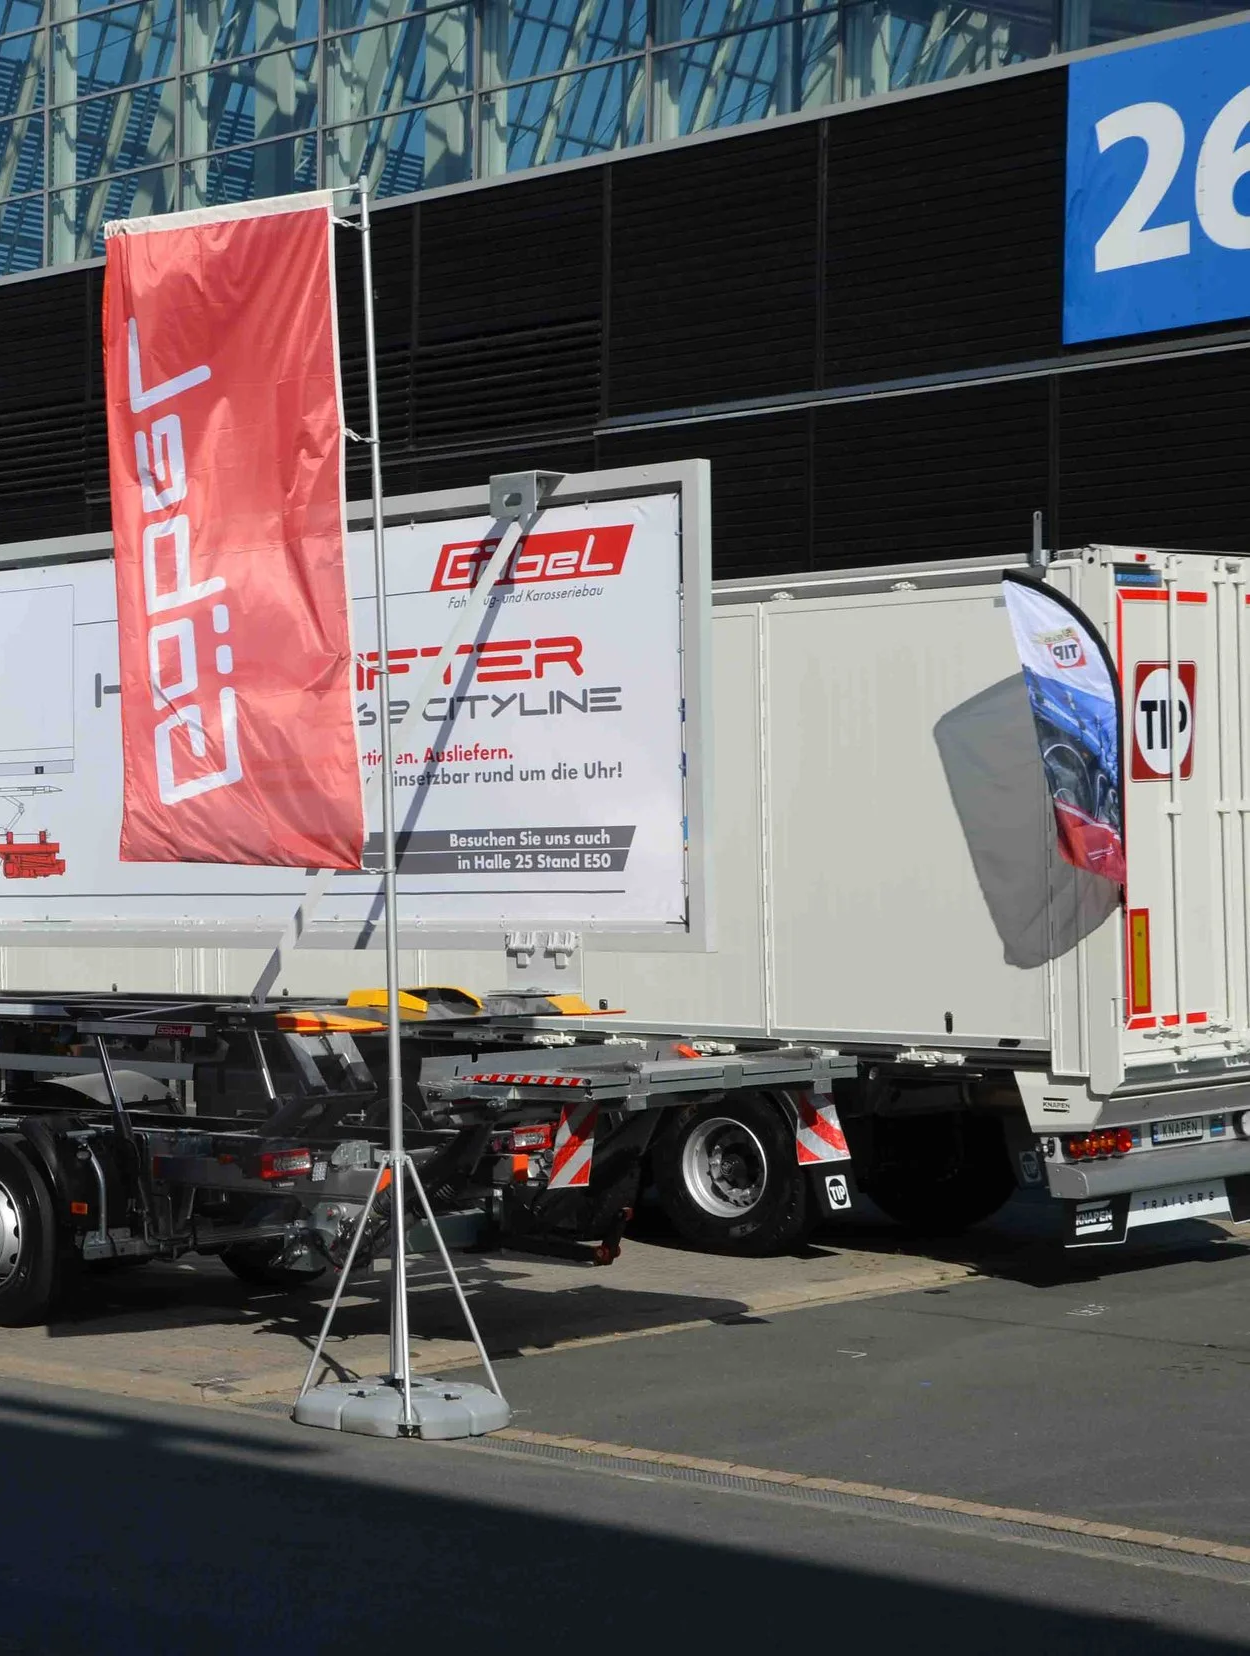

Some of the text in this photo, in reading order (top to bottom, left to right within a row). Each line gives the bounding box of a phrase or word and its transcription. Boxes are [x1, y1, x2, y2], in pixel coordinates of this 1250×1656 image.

[1095, 84, 1250, 273] 26
[503, 591, 522, 604] und
[526, 585, 604, 602] Karosseriebau
[424, 743, 513, 763] Ausliefern.
[475, 762, 514, 784] rund
[519, 766, 546, 781] um
[552, 761, 579, 780] die
[584, 761, 623, 780] Uhr!
[450, 830, 611, 848] Besuchen Sie uns auch
[457, 853, 611, 870] in Halle 25 Stand E50
[1161, 1119, 1198, 1137] KNAPEN
[830, 1185, 846, 1201] TIP
[1142, 1191, 1215, 1211] TRAILERS
[1075, 1209, 1113, 1226] KNAPEN
